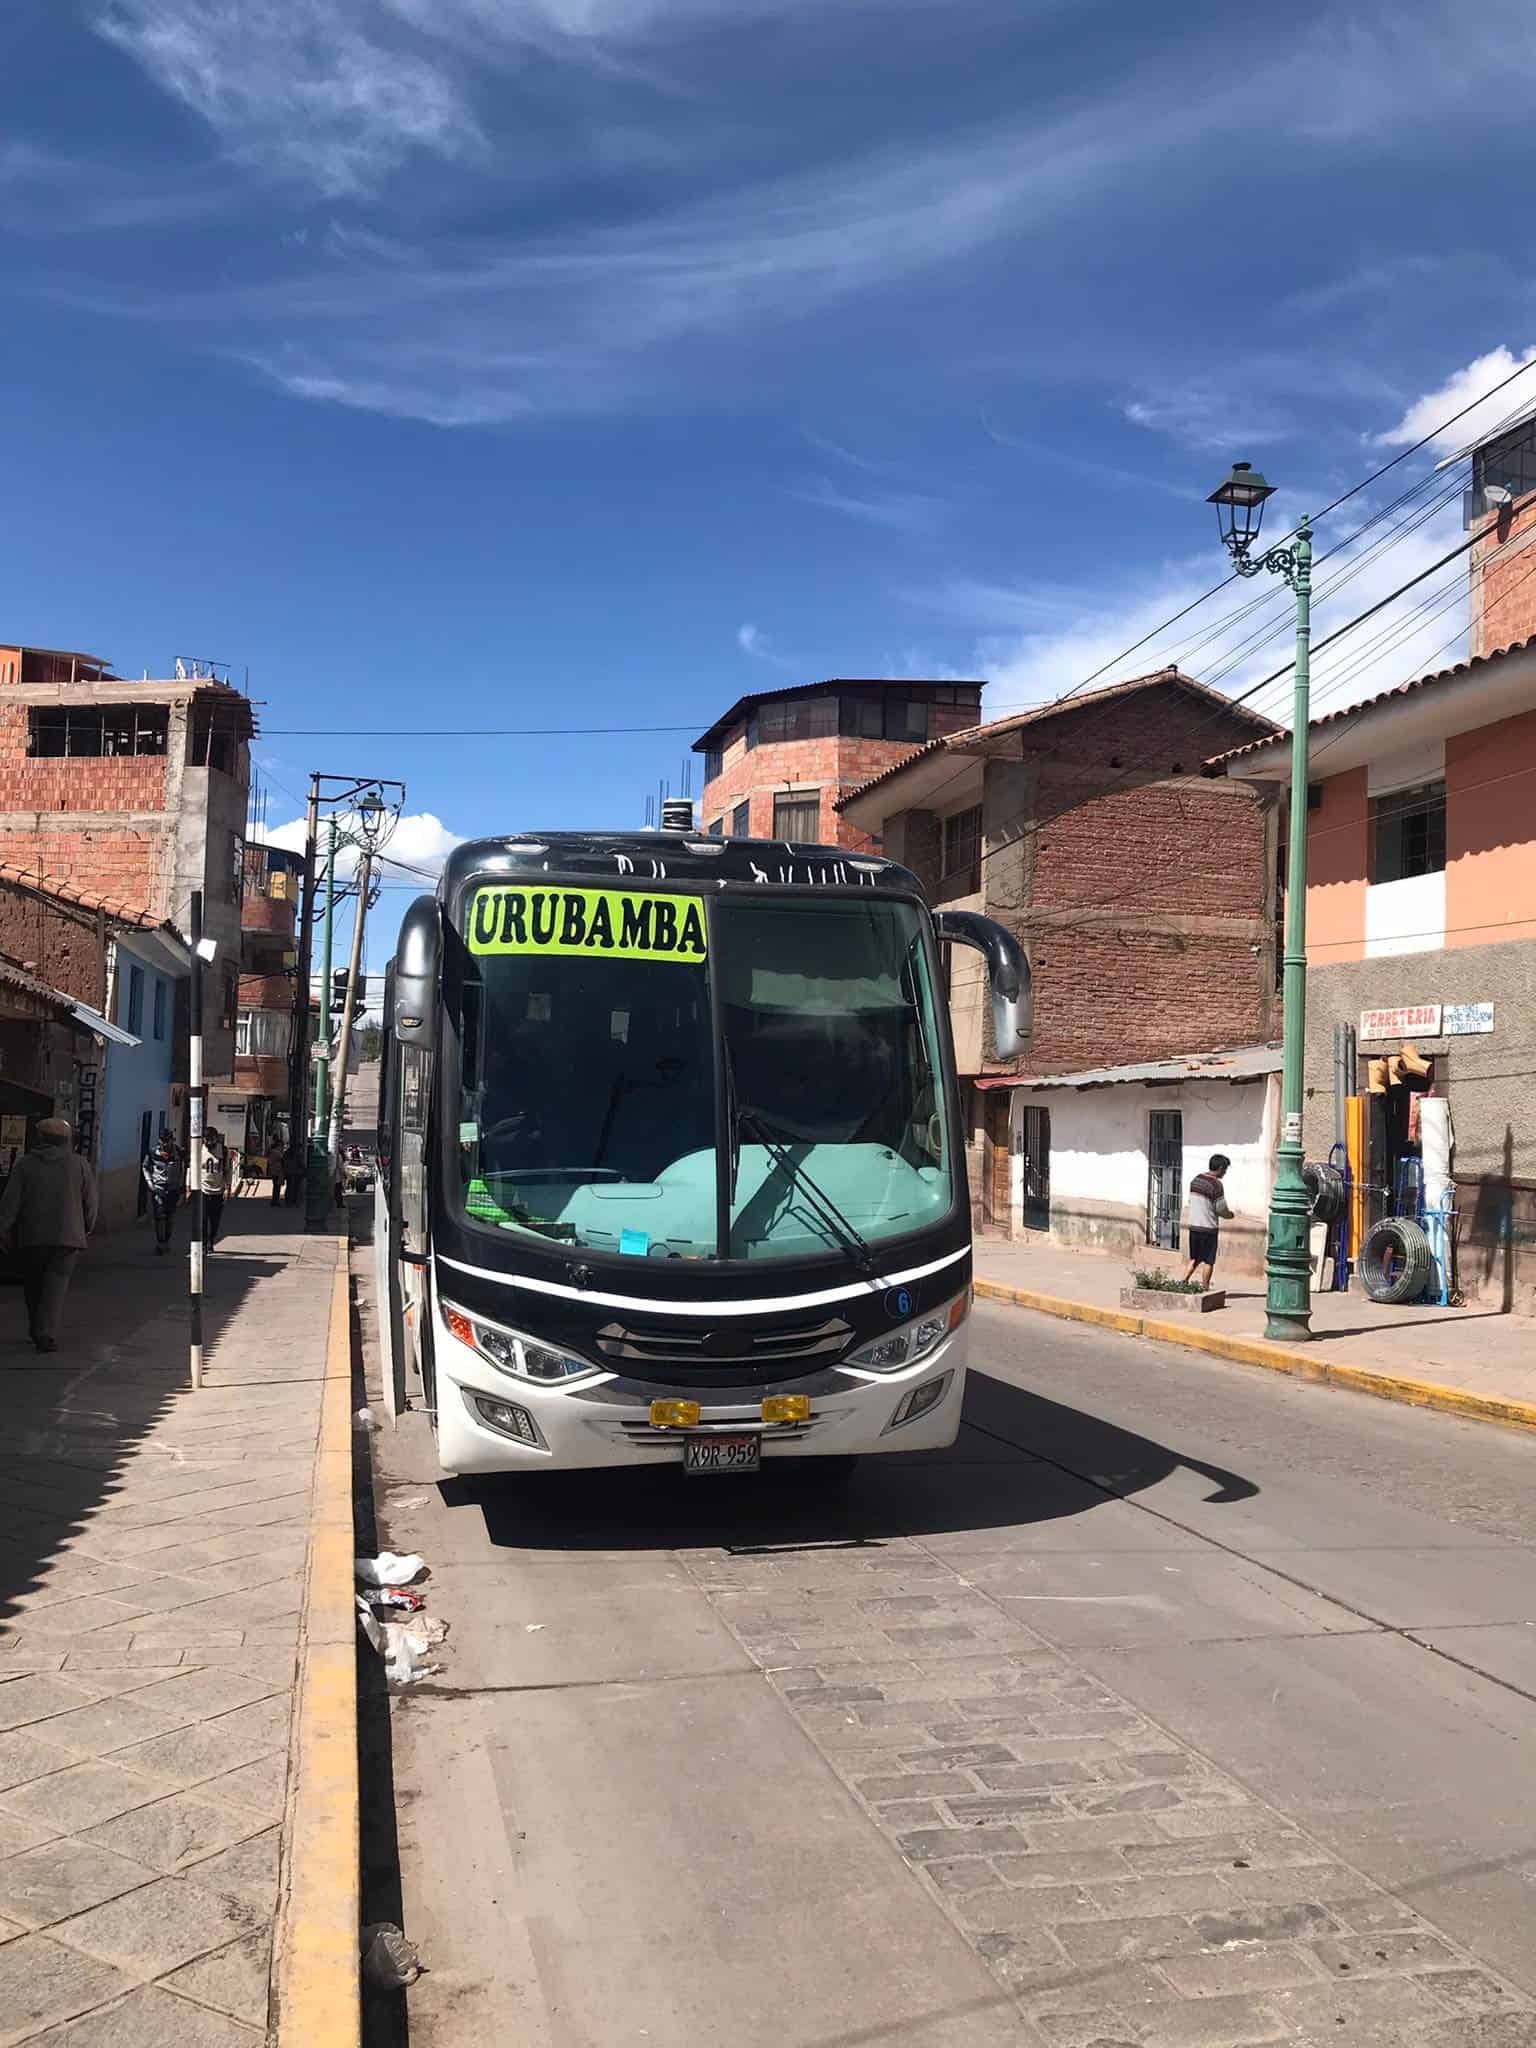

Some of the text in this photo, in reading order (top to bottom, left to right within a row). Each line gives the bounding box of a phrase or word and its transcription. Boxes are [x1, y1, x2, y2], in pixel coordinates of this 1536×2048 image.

[475, 893, 706, 954] URUBAMBA
[898, 1292, 909, 1313] 6
[690, 1445, 757, 1466] X9R-952
